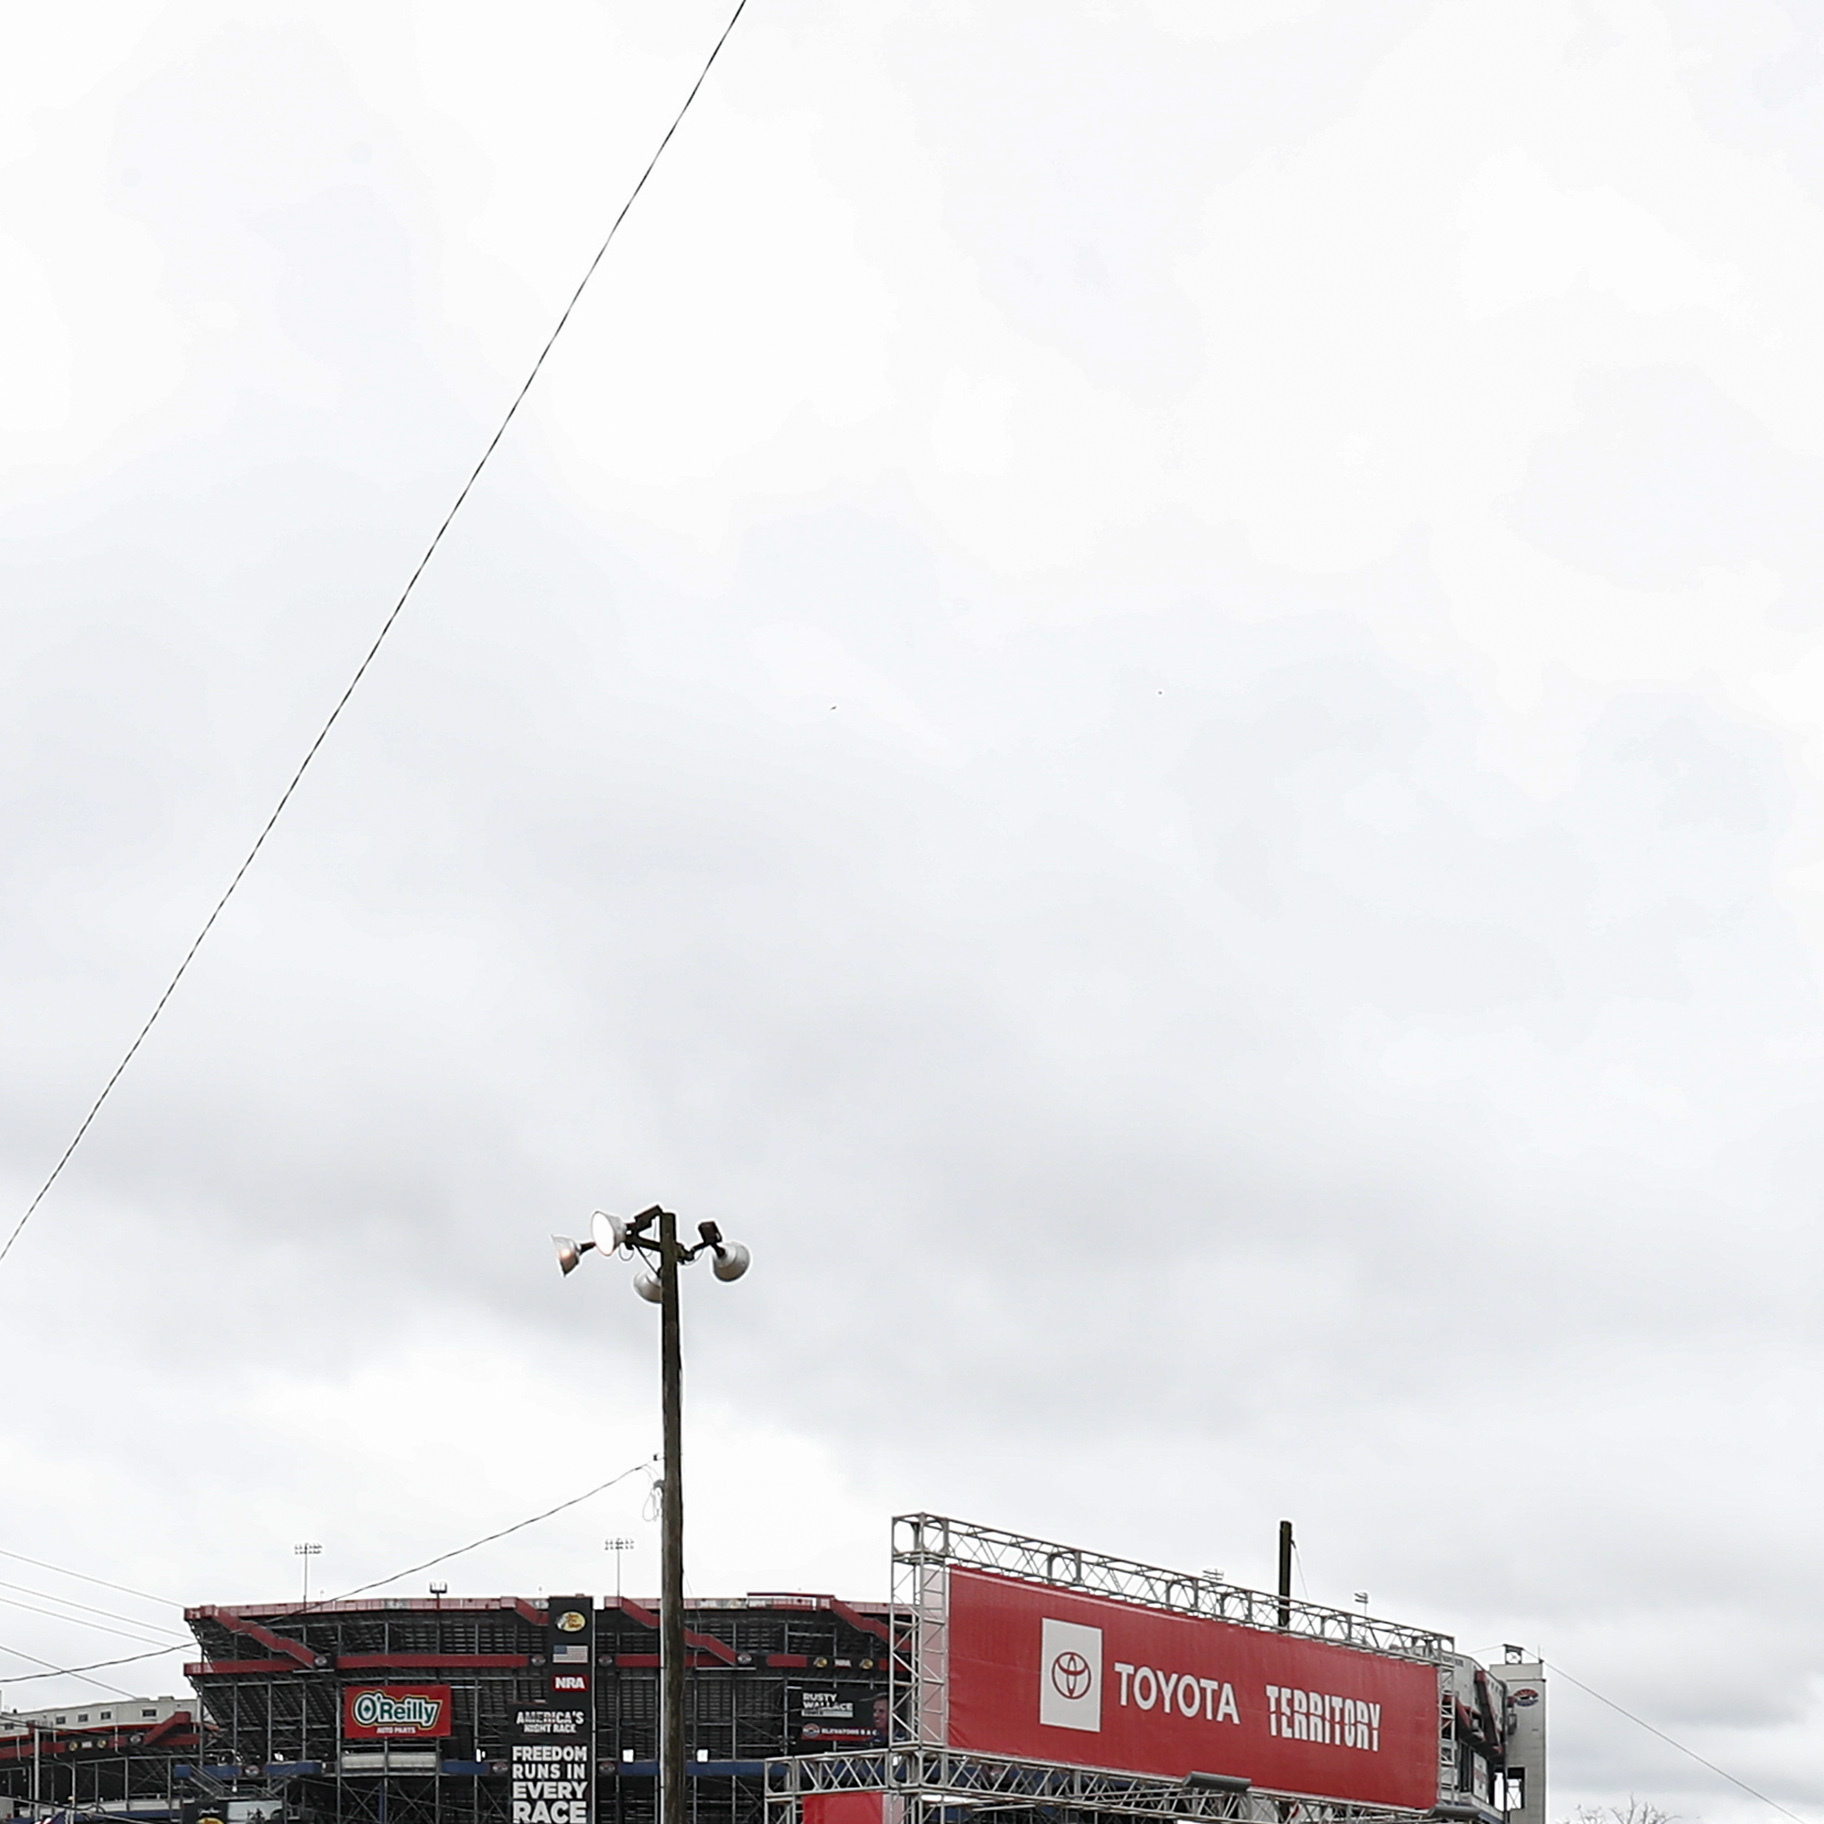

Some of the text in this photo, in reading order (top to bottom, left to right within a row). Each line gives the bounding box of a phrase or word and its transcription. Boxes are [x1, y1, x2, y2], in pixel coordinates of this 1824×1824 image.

[555, 1677, 585, 1689] NRA
[803, 1693, 837, 1702] RUSTY
[355, 1693, 438, 1726] O'Reilly
[803, 1702, 854, 1711] WALLACE
[1114, 1661, 1381, 1752] TOYOTA TERRITORY
[516, 1711, 584, 1725] AMERICA'S
[376, 1726, 417, 1735] AUTO PARTS
[524, 1724, 577, 1734] NIGHT RACE
[512, 1746, 588, 1762] FREEDOM
[512, 1764, 586, 1779] RUNS IN
[512, 1781, 588, 1799] EVERY
[513, 1801, 588, 1824] RACE
